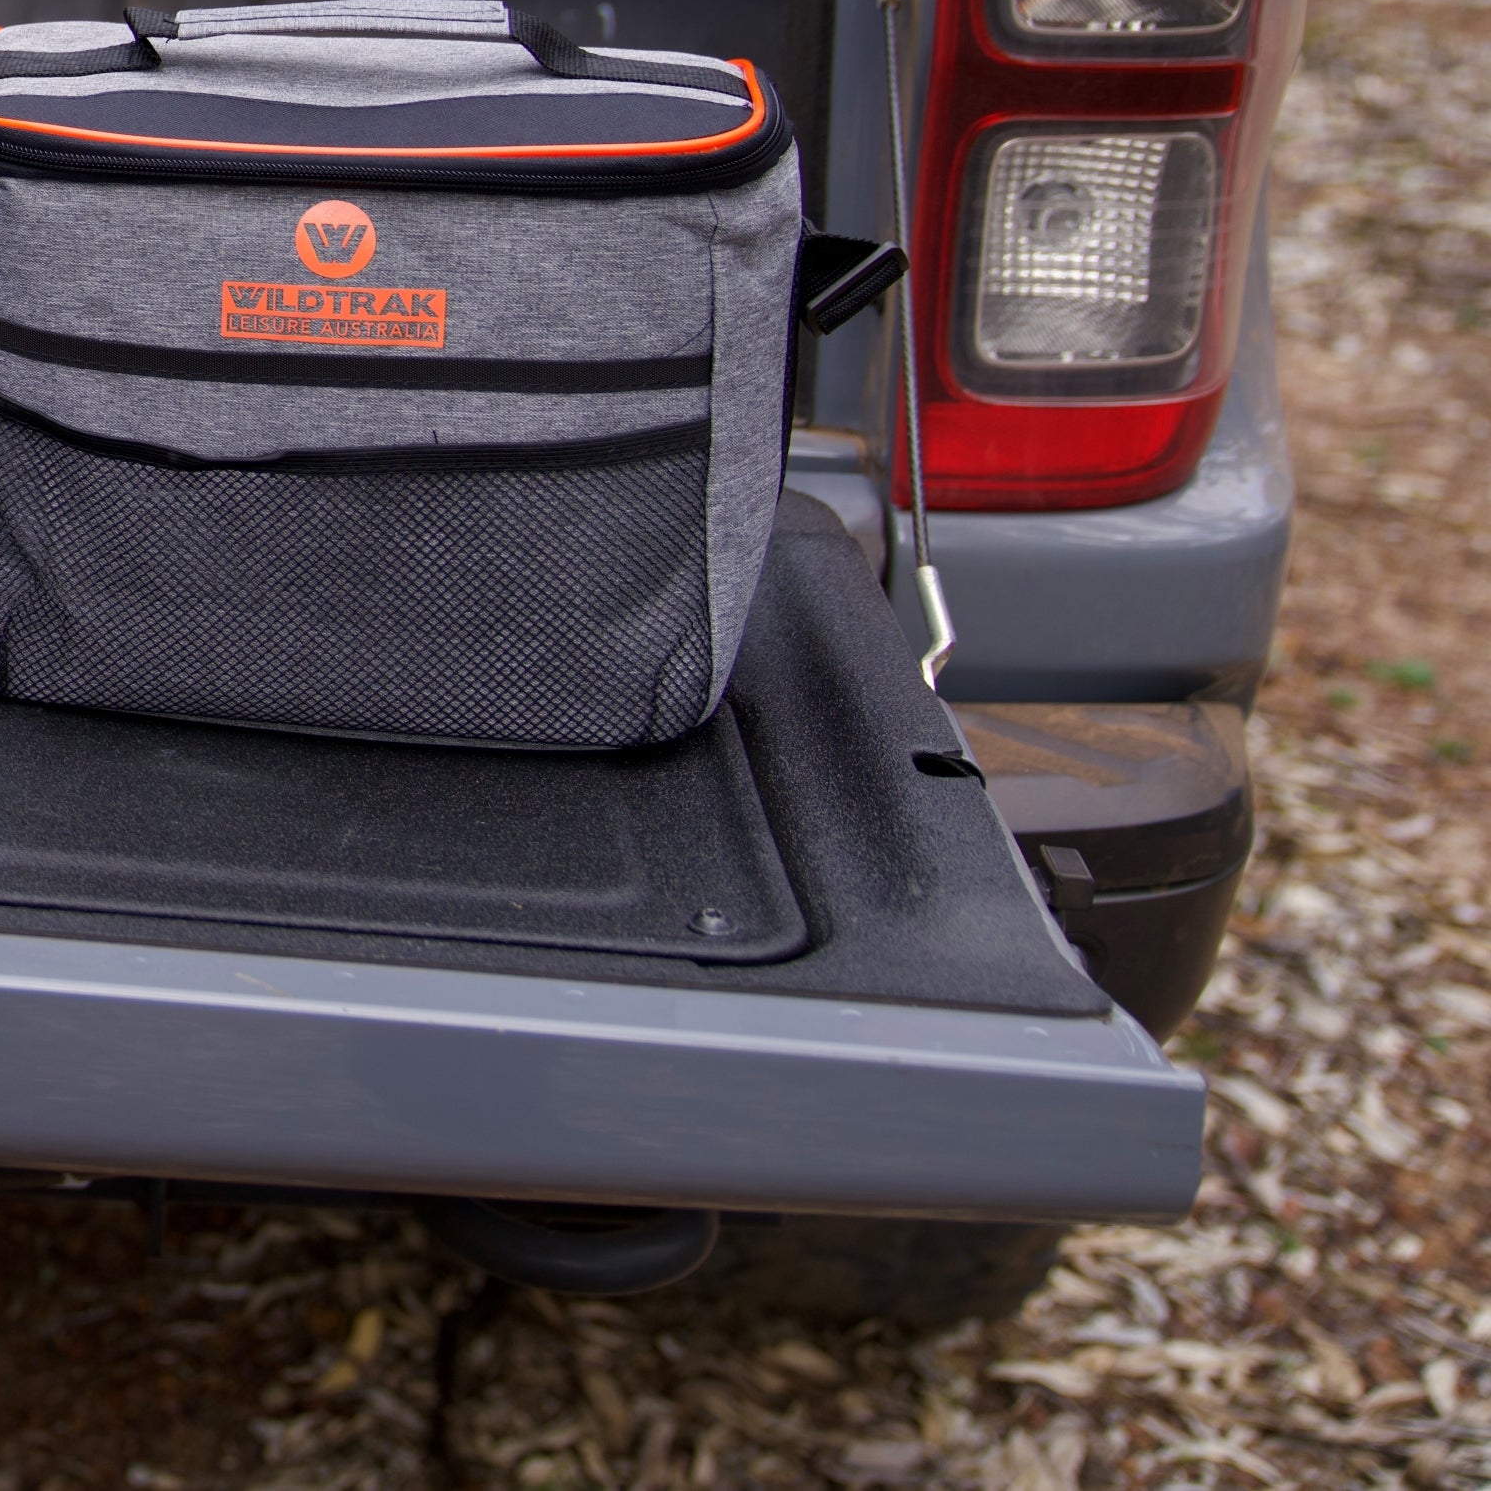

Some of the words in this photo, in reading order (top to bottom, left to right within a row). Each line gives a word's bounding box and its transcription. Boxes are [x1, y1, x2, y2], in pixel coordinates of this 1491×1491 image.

[227, 285, 439, 318] WILDTRAK
[229, 316, 312, 335] LEISURE
[320, 320, 438, 341] AUSTRALIA
